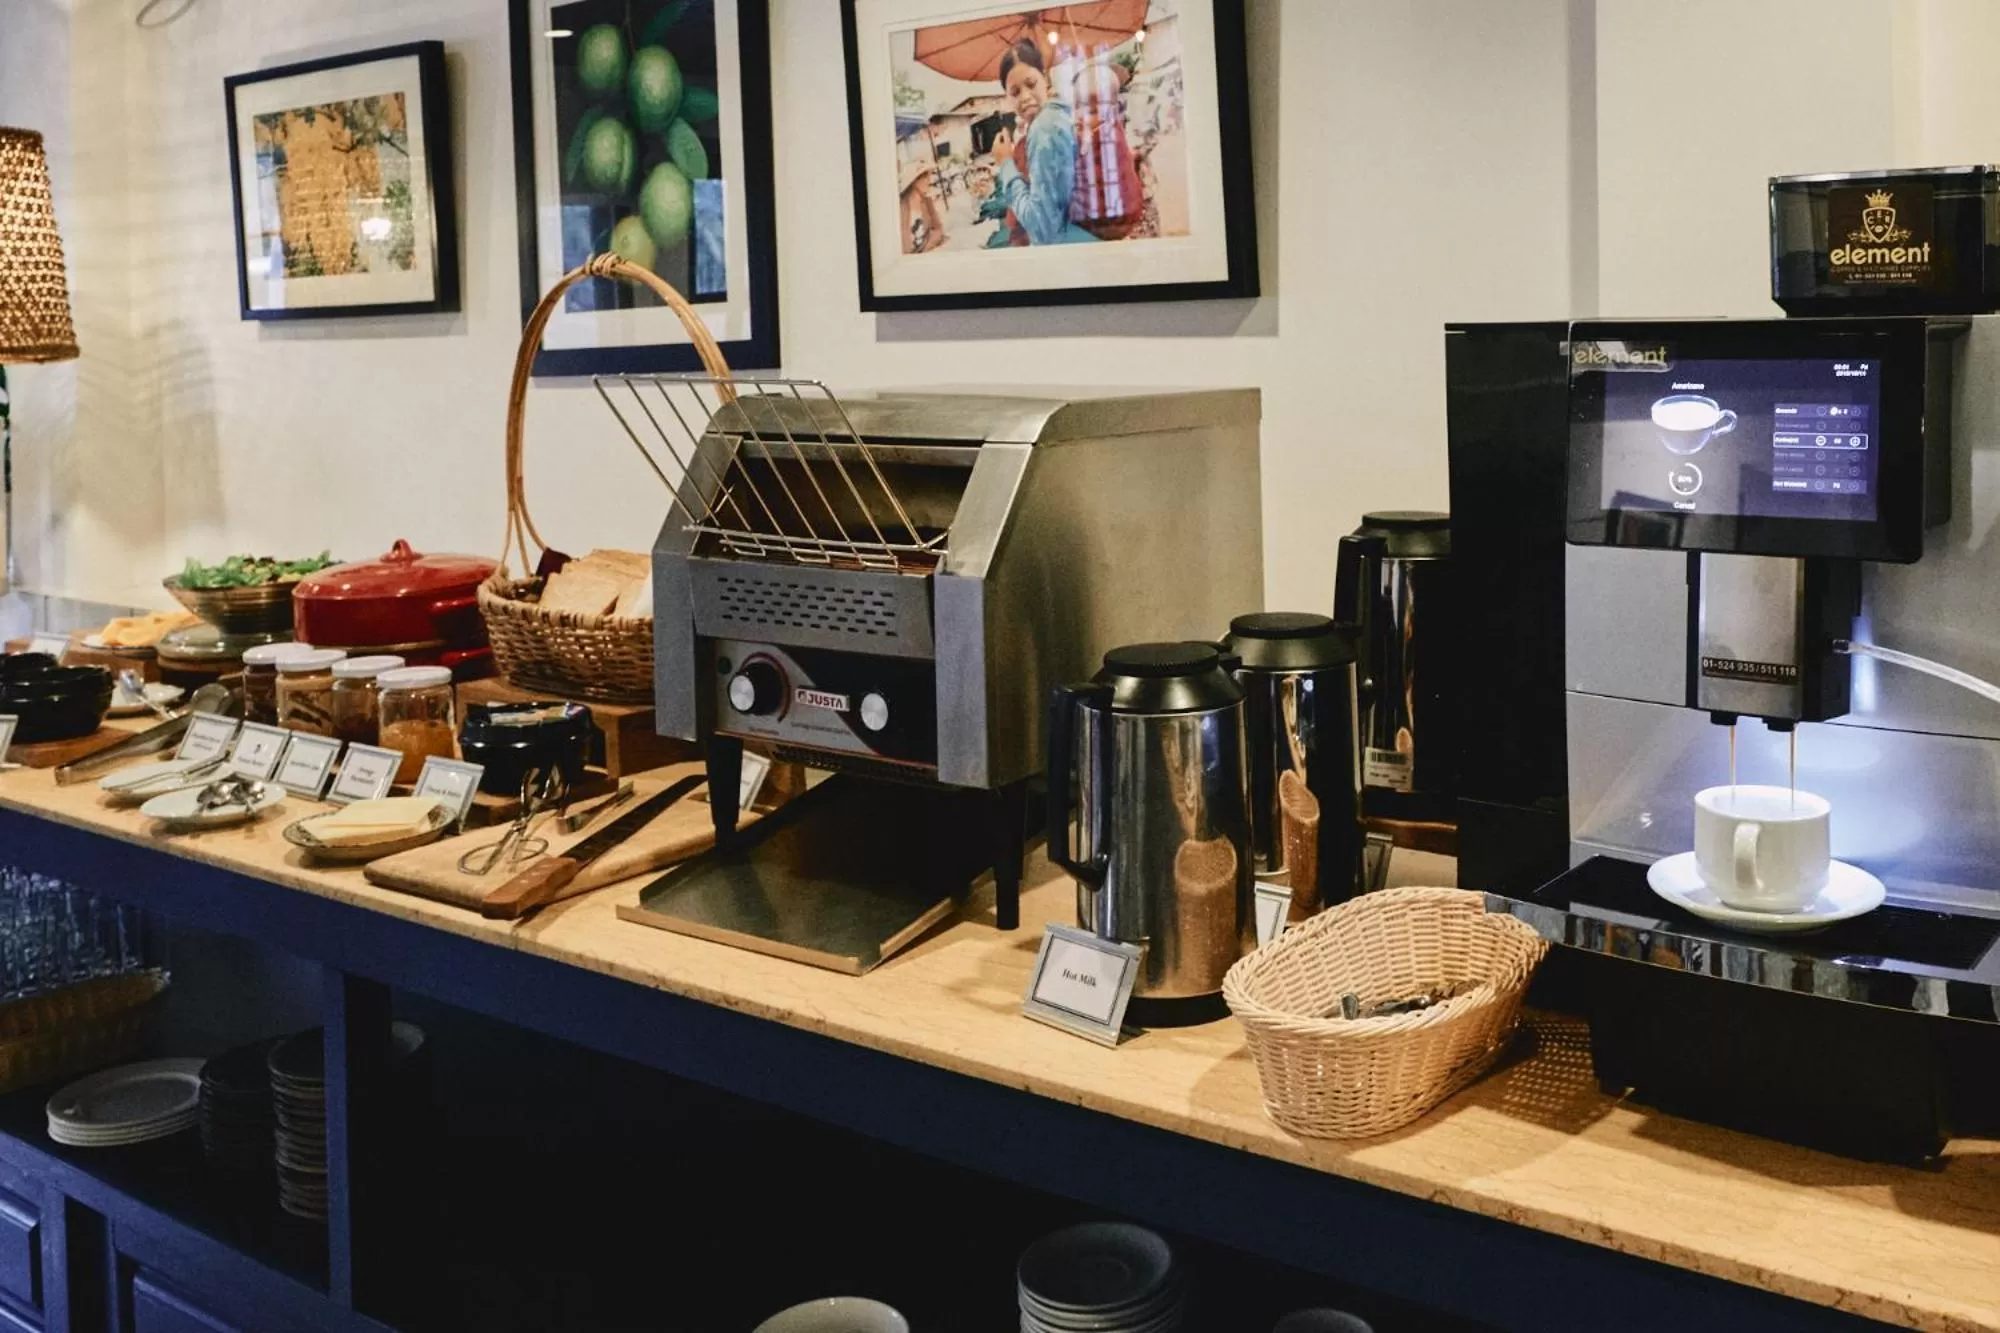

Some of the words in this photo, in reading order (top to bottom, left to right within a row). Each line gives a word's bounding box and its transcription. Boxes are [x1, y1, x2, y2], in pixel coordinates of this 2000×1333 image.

[1830, 241, 1930, 265] element
[1574, 347, 1667, 364] element
[807, 693, 844, 710] JUSTA
[1062, 967, 1078, 981] Hot
[1079, 973, 1097, 988] Milk
